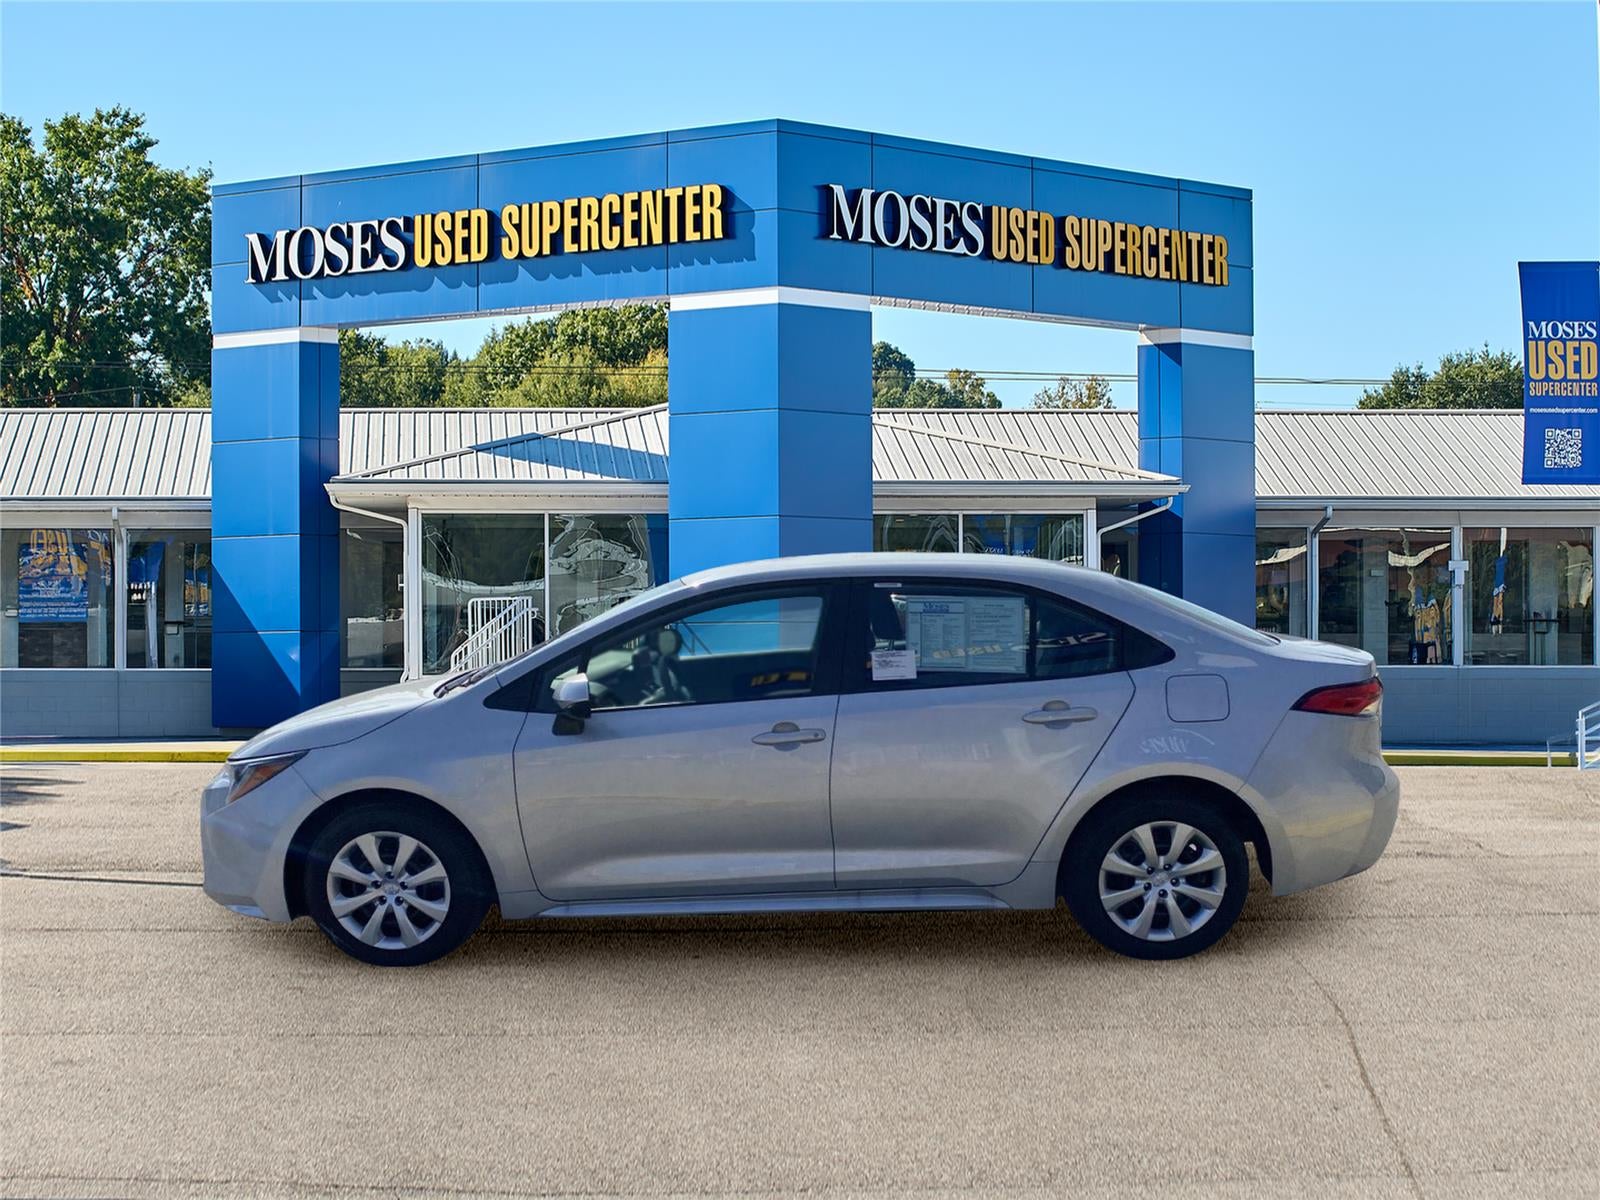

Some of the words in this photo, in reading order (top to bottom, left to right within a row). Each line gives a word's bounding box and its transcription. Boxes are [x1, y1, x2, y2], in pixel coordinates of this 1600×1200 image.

[244, 215, 410, 284] MOSES
[413, 208, 489, 268] USED
[501, 183, 725, 260] SUPERCENTER
[829, 183, 985, 257] MOSES
[991, 204, 1056, 265] USED
[1065, 214, 1230, 287] SUPERCENTER
[1528, 320, 1597, 339] MOSES
[1528, 340, 1598, 380] USED
[1529, 381, 1598, 397] SUPERCENTER
[1529, 406, 1598, 414] mosesusedsupercenter.com
